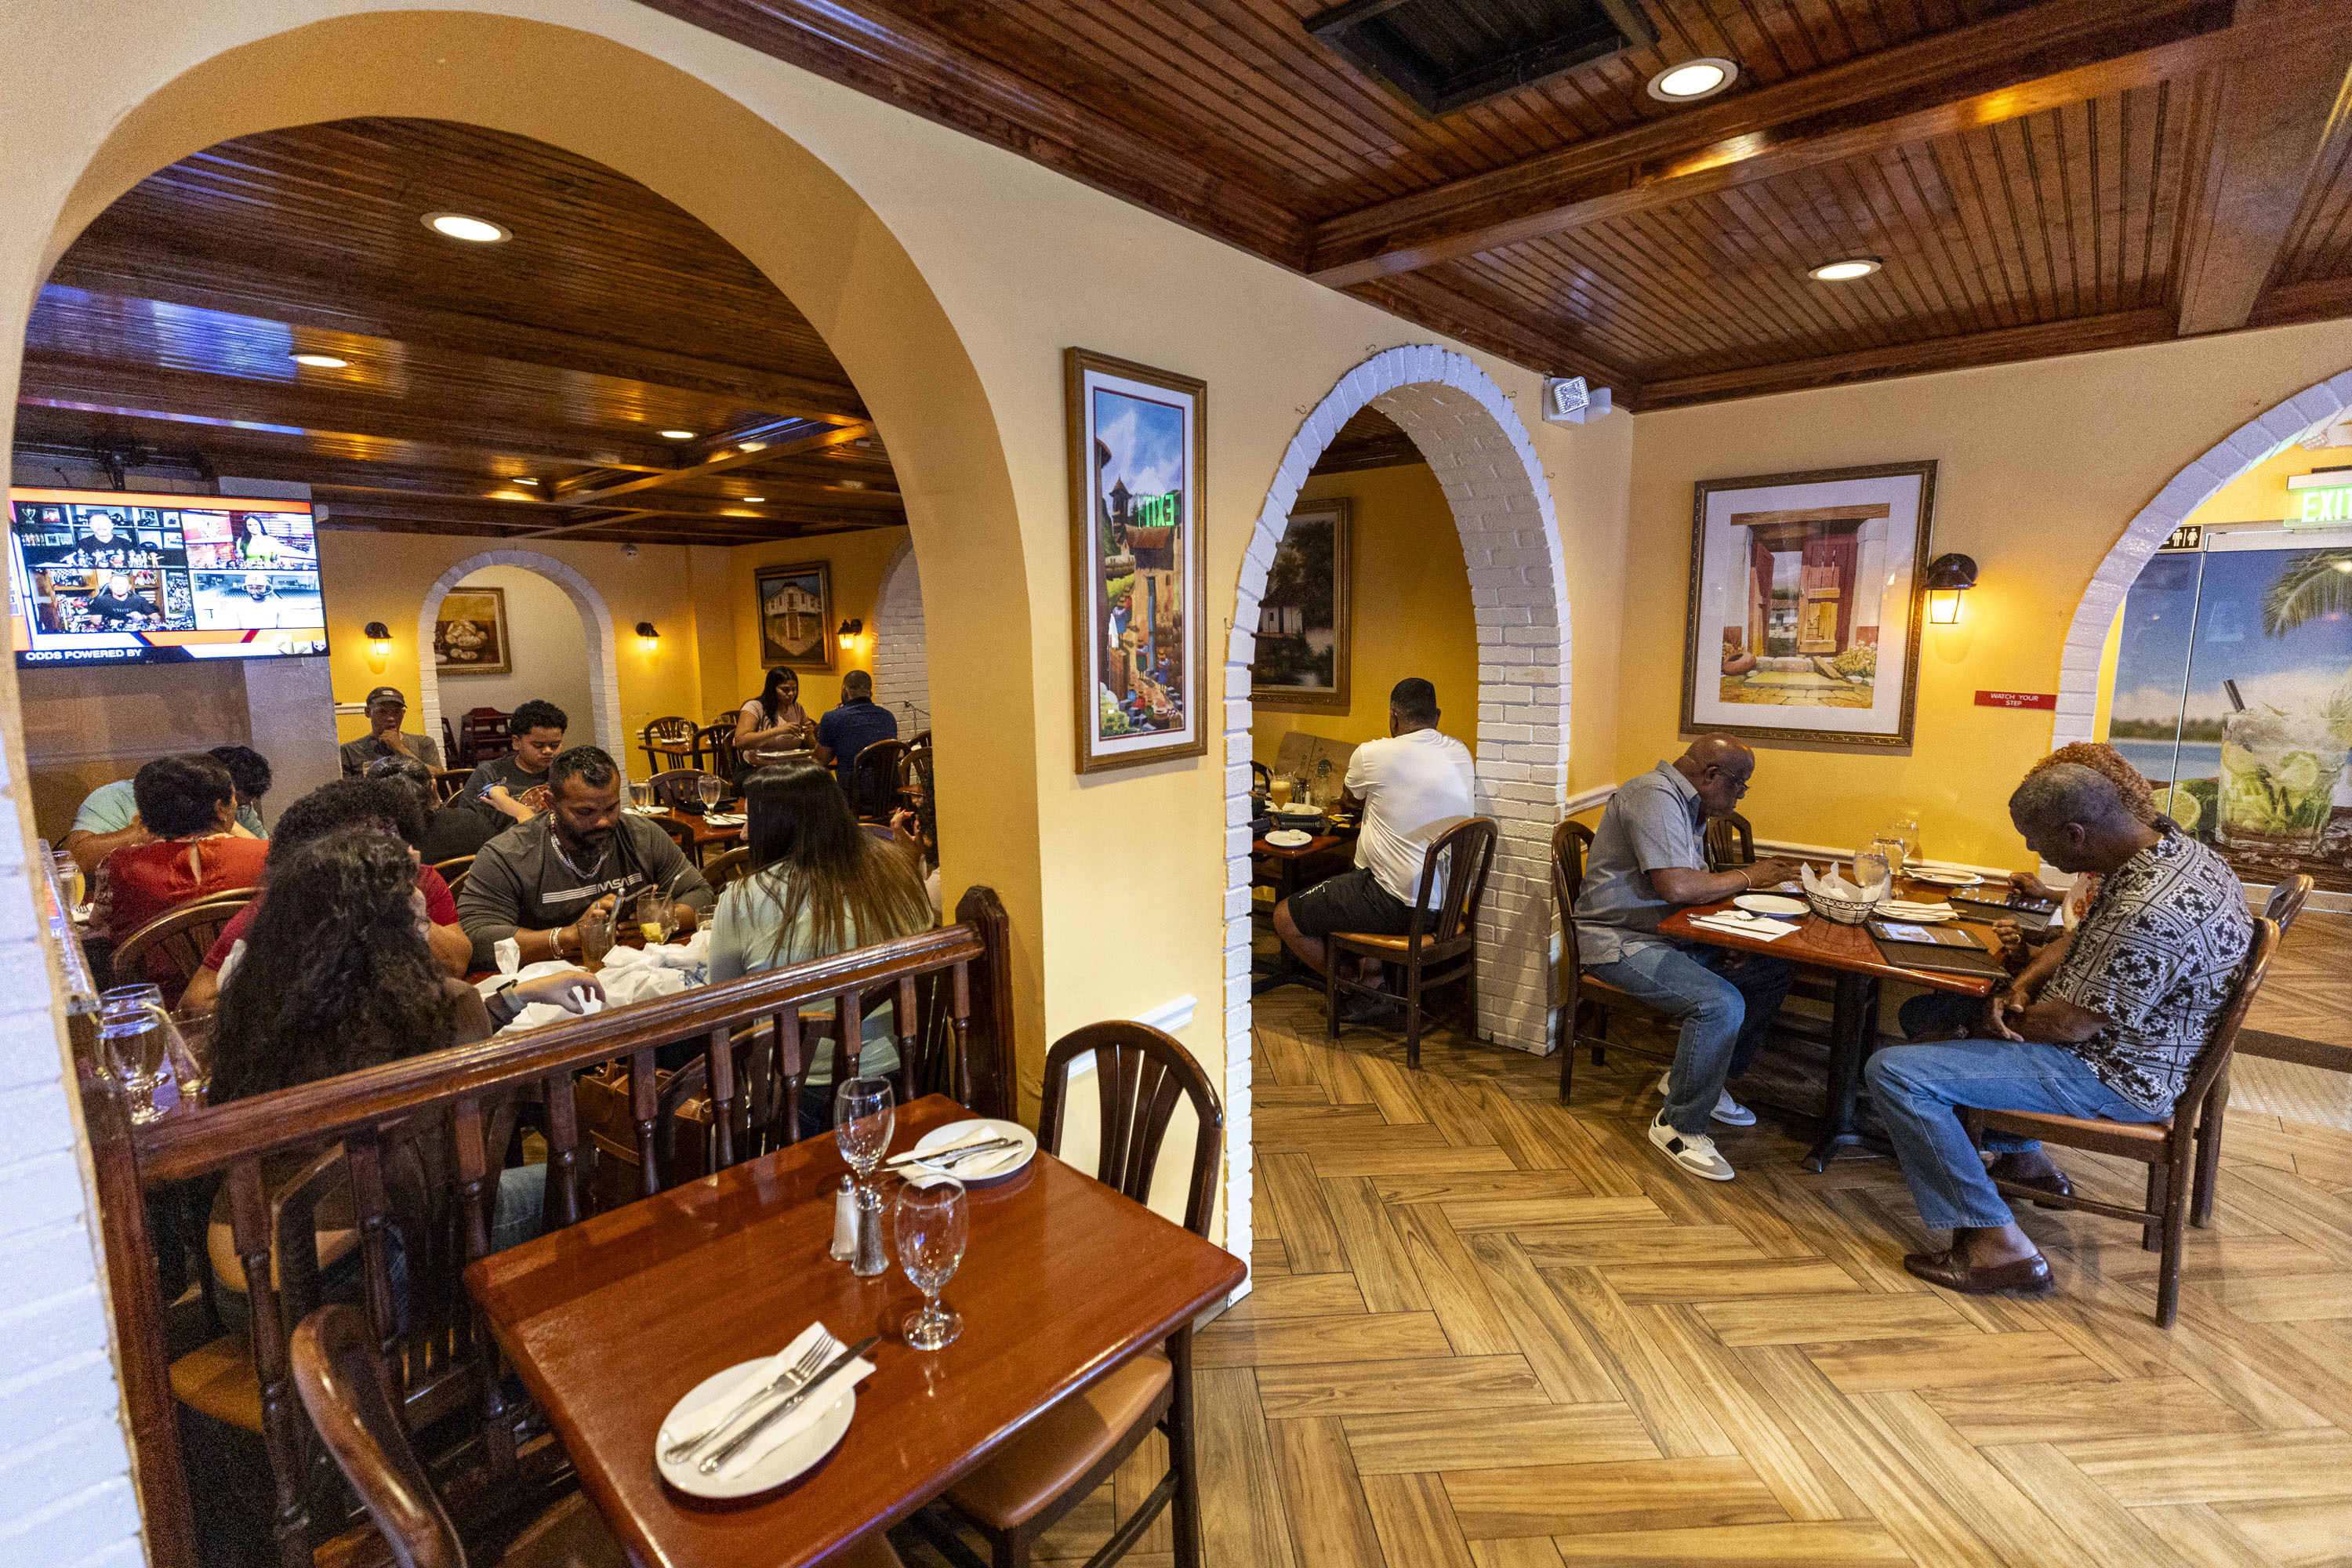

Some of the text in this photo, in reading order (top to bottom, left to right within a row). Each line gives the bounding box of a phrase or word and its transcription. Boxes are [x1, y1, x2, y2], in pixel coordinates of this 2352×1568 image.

[2301, 488, 2352, 523] EXIT
[25, 648, 143, 661] ODDS POWERED BY
[597, 877, 630, 893] NASA
